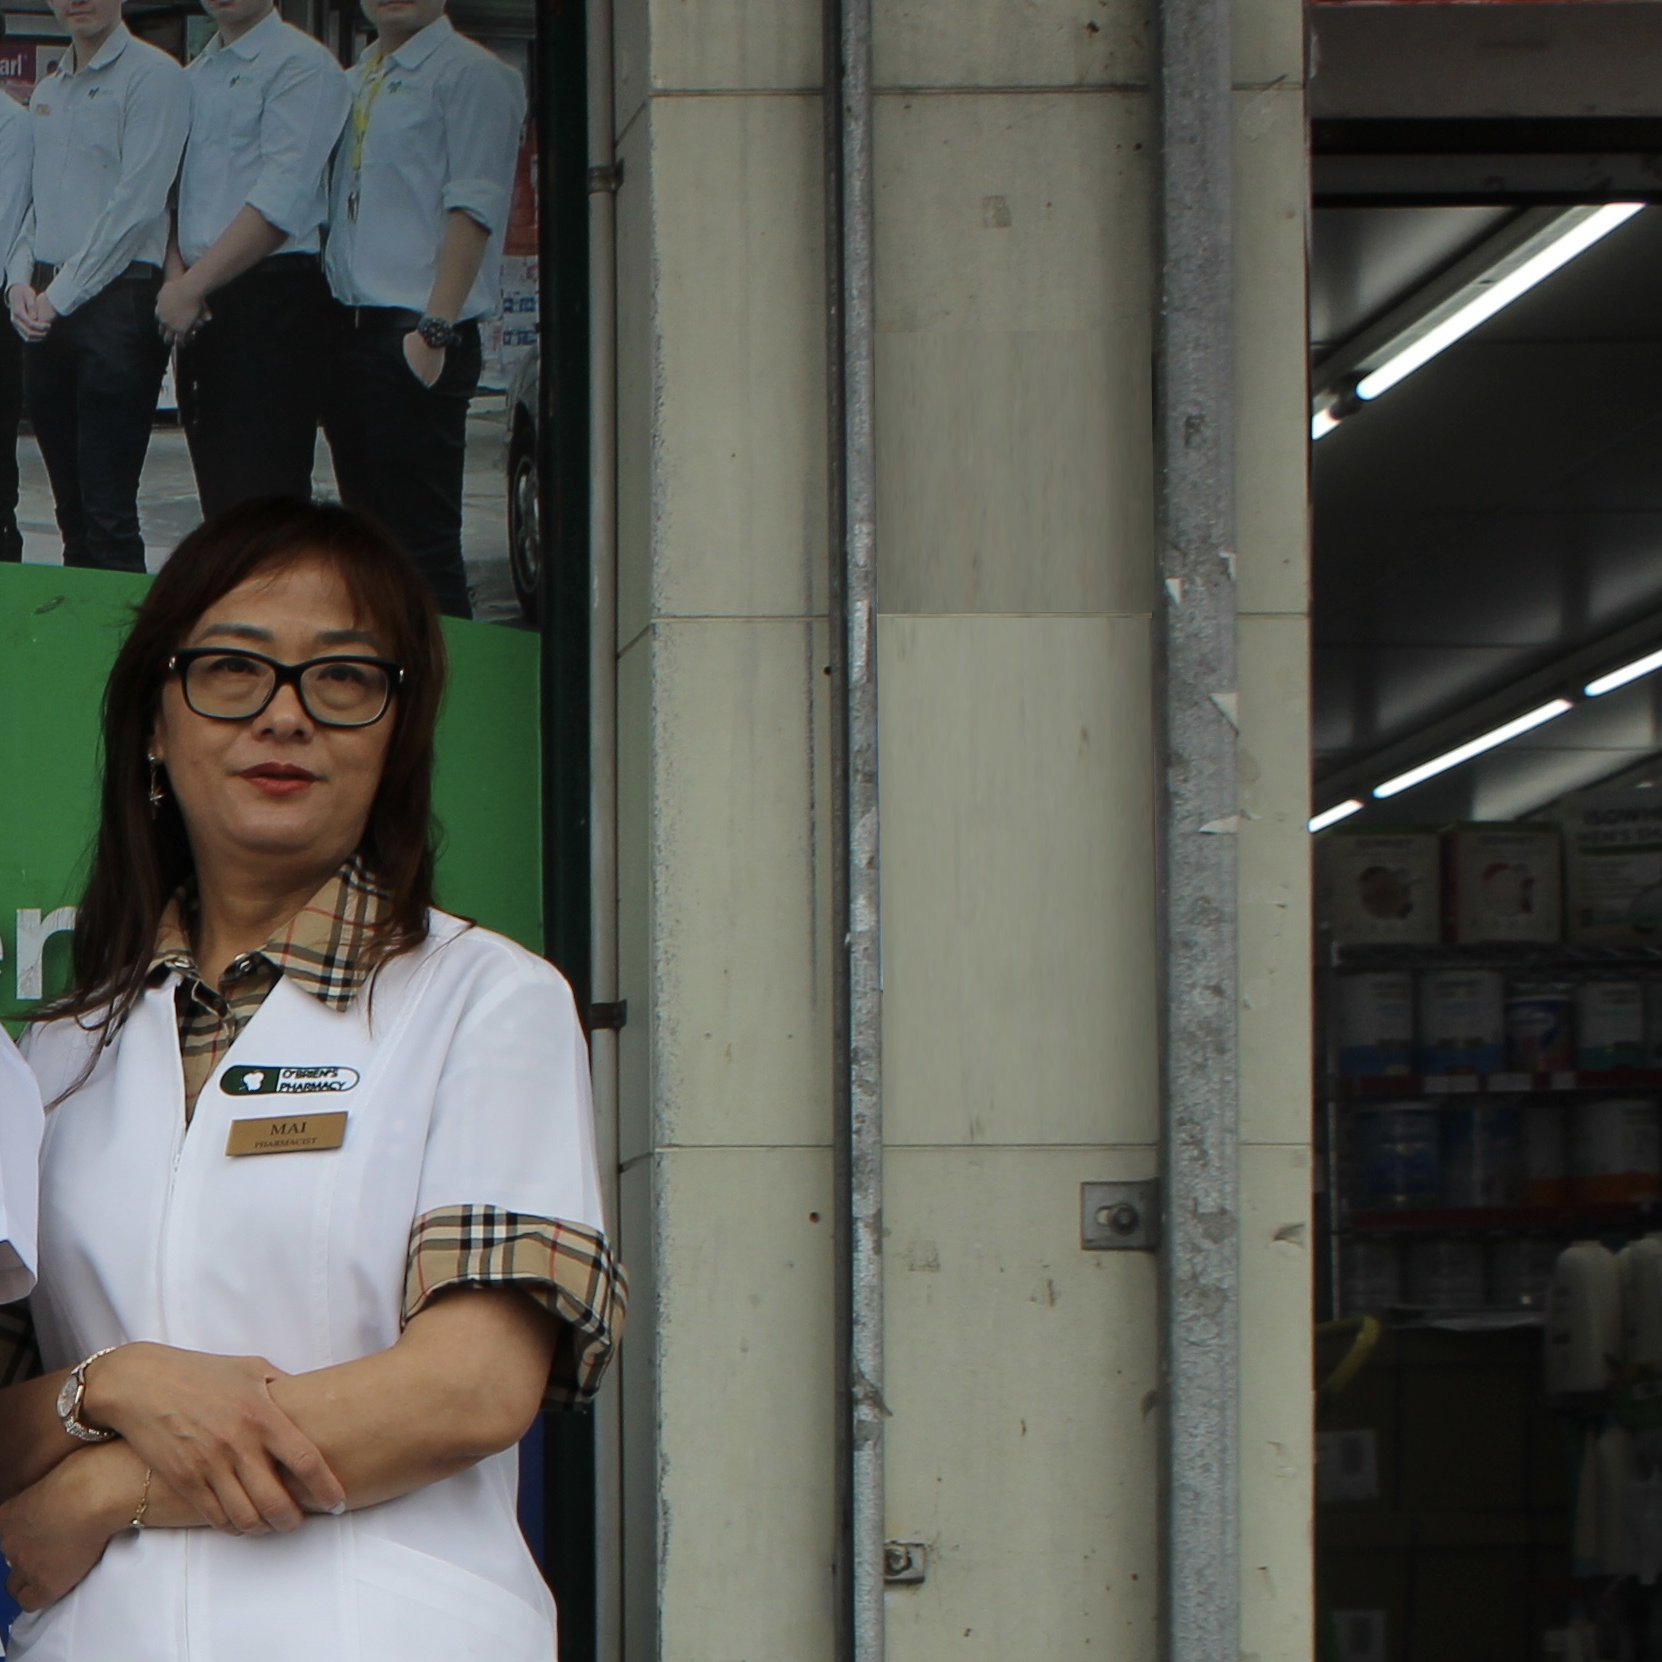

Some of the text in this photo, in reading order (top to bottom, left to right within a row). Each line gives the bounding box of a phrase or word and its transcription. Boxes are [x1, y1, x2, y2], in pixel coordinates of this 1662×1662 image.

[282, 1068, 338, 1080] O'BRIEN'S
[276, 1080, 347, 1093] PHARMACY
[270, 1121, 308, 1136] MAI
[254, 1137, 317, 1149] PHARMACIST
